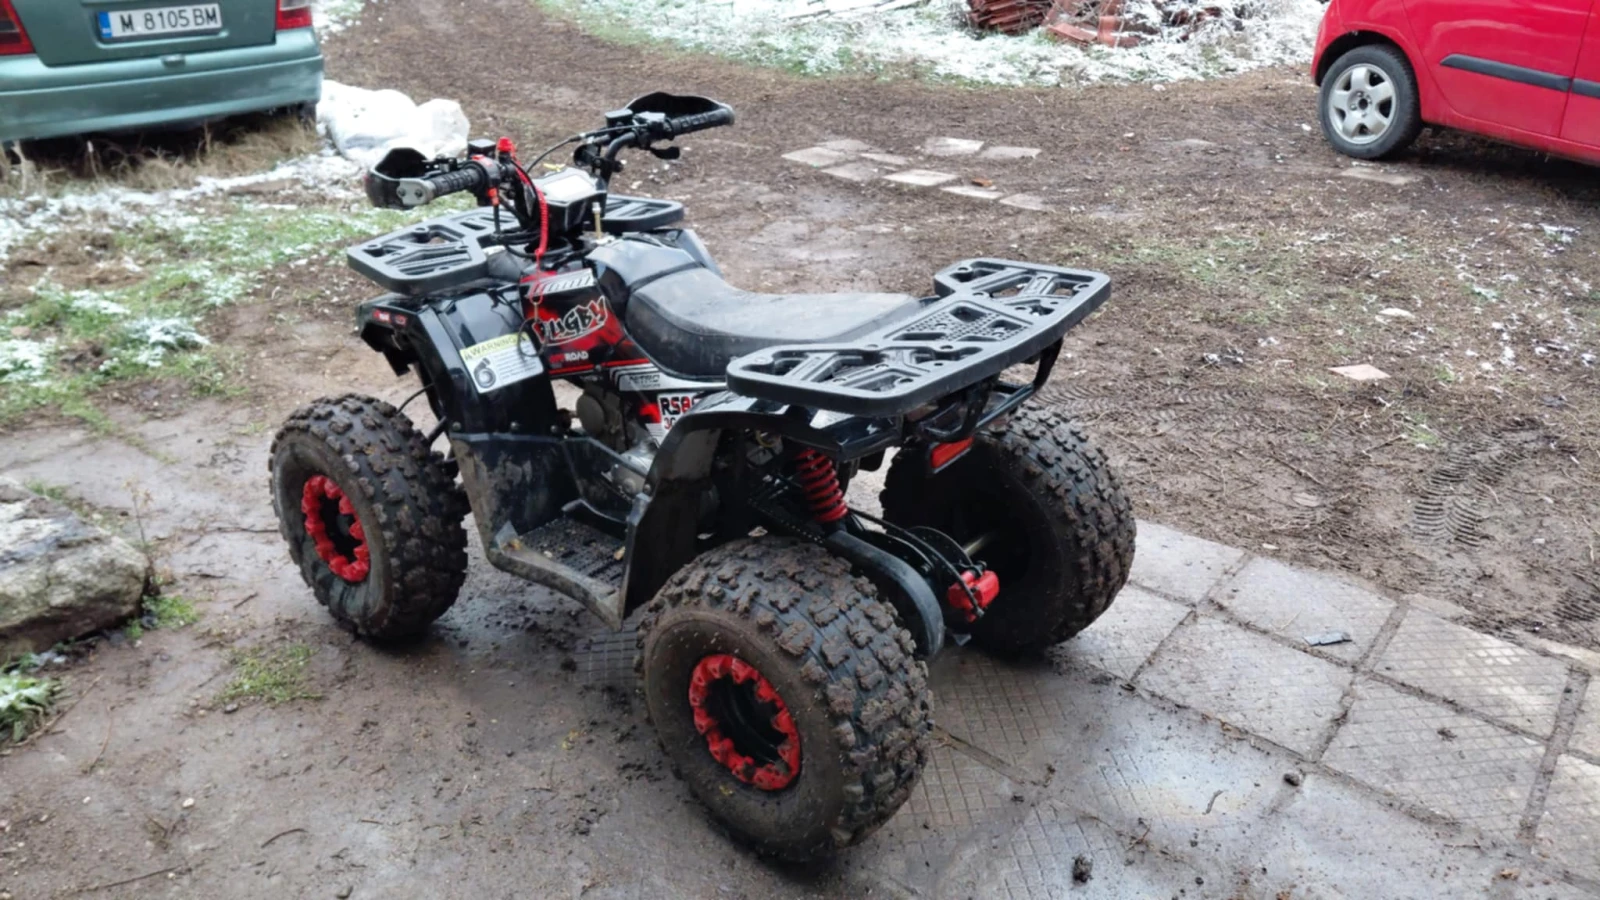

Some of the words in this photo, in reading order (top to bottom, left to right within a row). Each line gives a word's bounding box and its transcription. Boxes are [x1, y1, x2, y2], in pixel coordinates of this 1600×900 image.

[120, 13, 135, 32] M
[144, 9, 189, 30] 8105
[192, 7, 218, 26] BM
